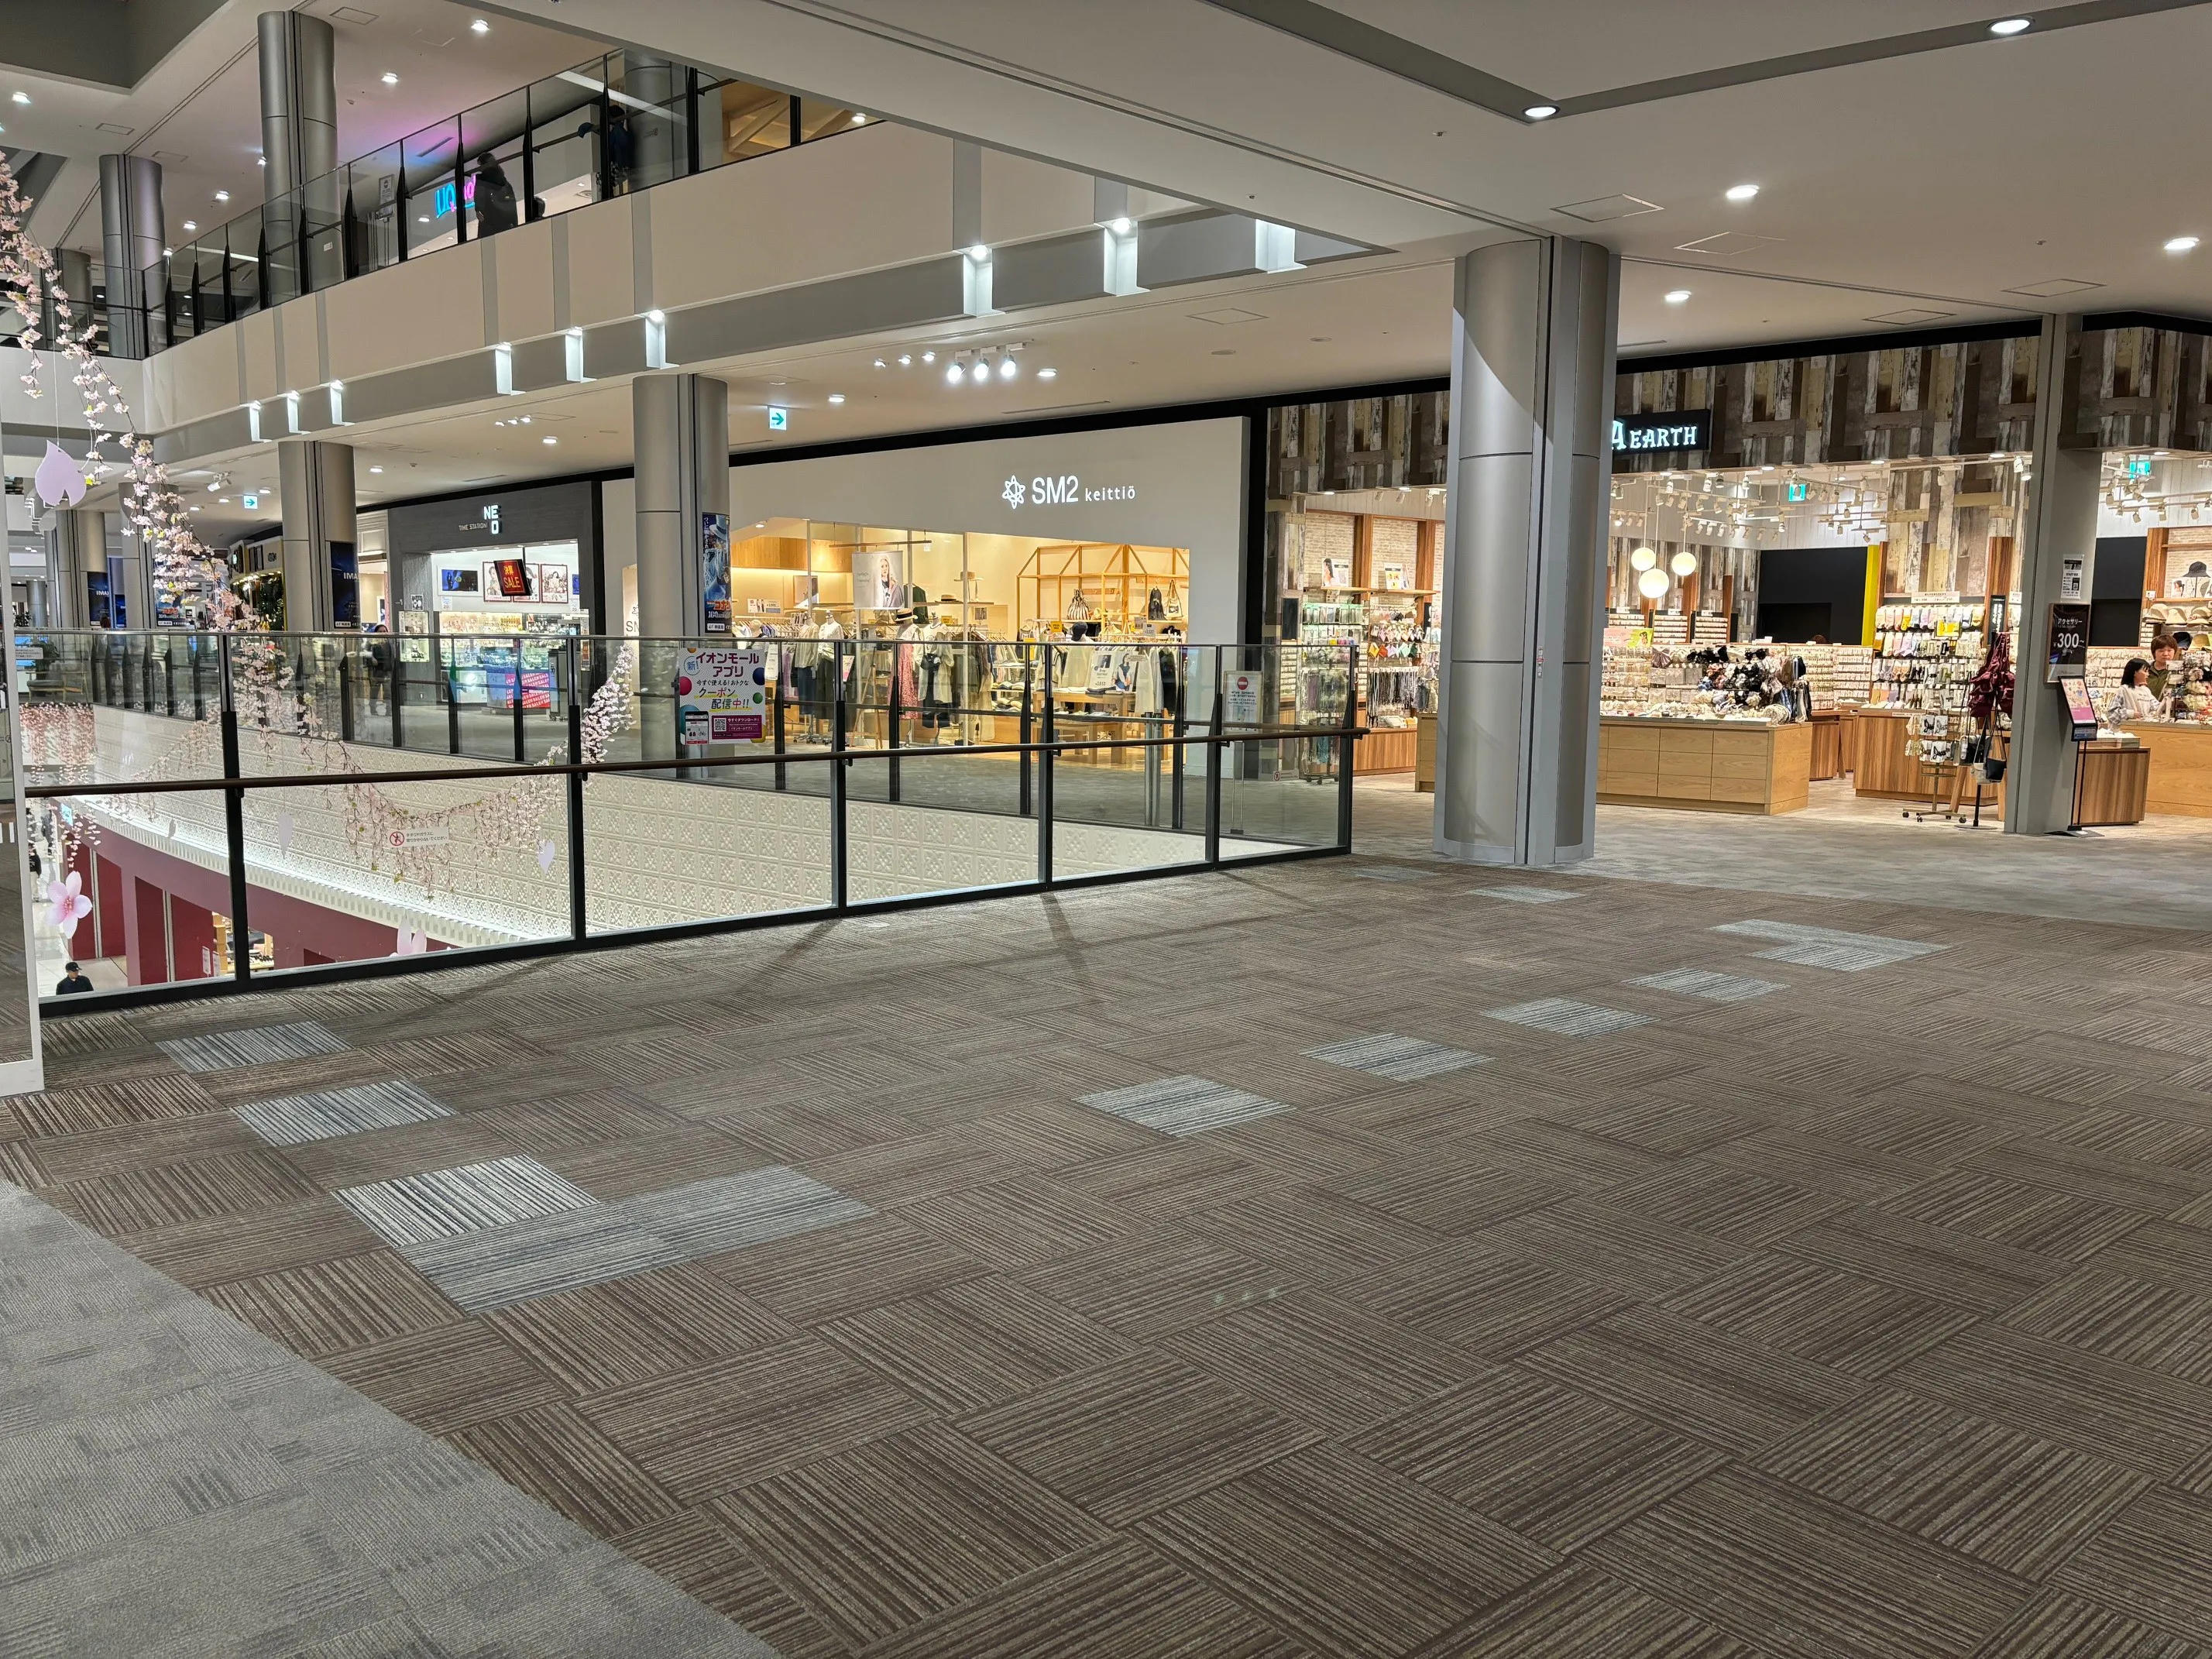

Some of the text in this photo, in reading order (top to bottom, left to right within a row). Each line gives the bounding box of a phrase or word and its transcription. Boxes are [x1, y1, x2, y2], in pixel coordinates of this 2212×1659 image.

[1630, 426, 1697, 449] EARTH
[1032, 475, 1135, 504] SM2 keittiö
[503, 577, 521, 589] SALE
[696, 652, 760, 665] イオンモール
[713, 665, 744, 678] アプリ
[699, 687, 736, 698] クーポン
[711, 698, 749, 709] 配信中!!
